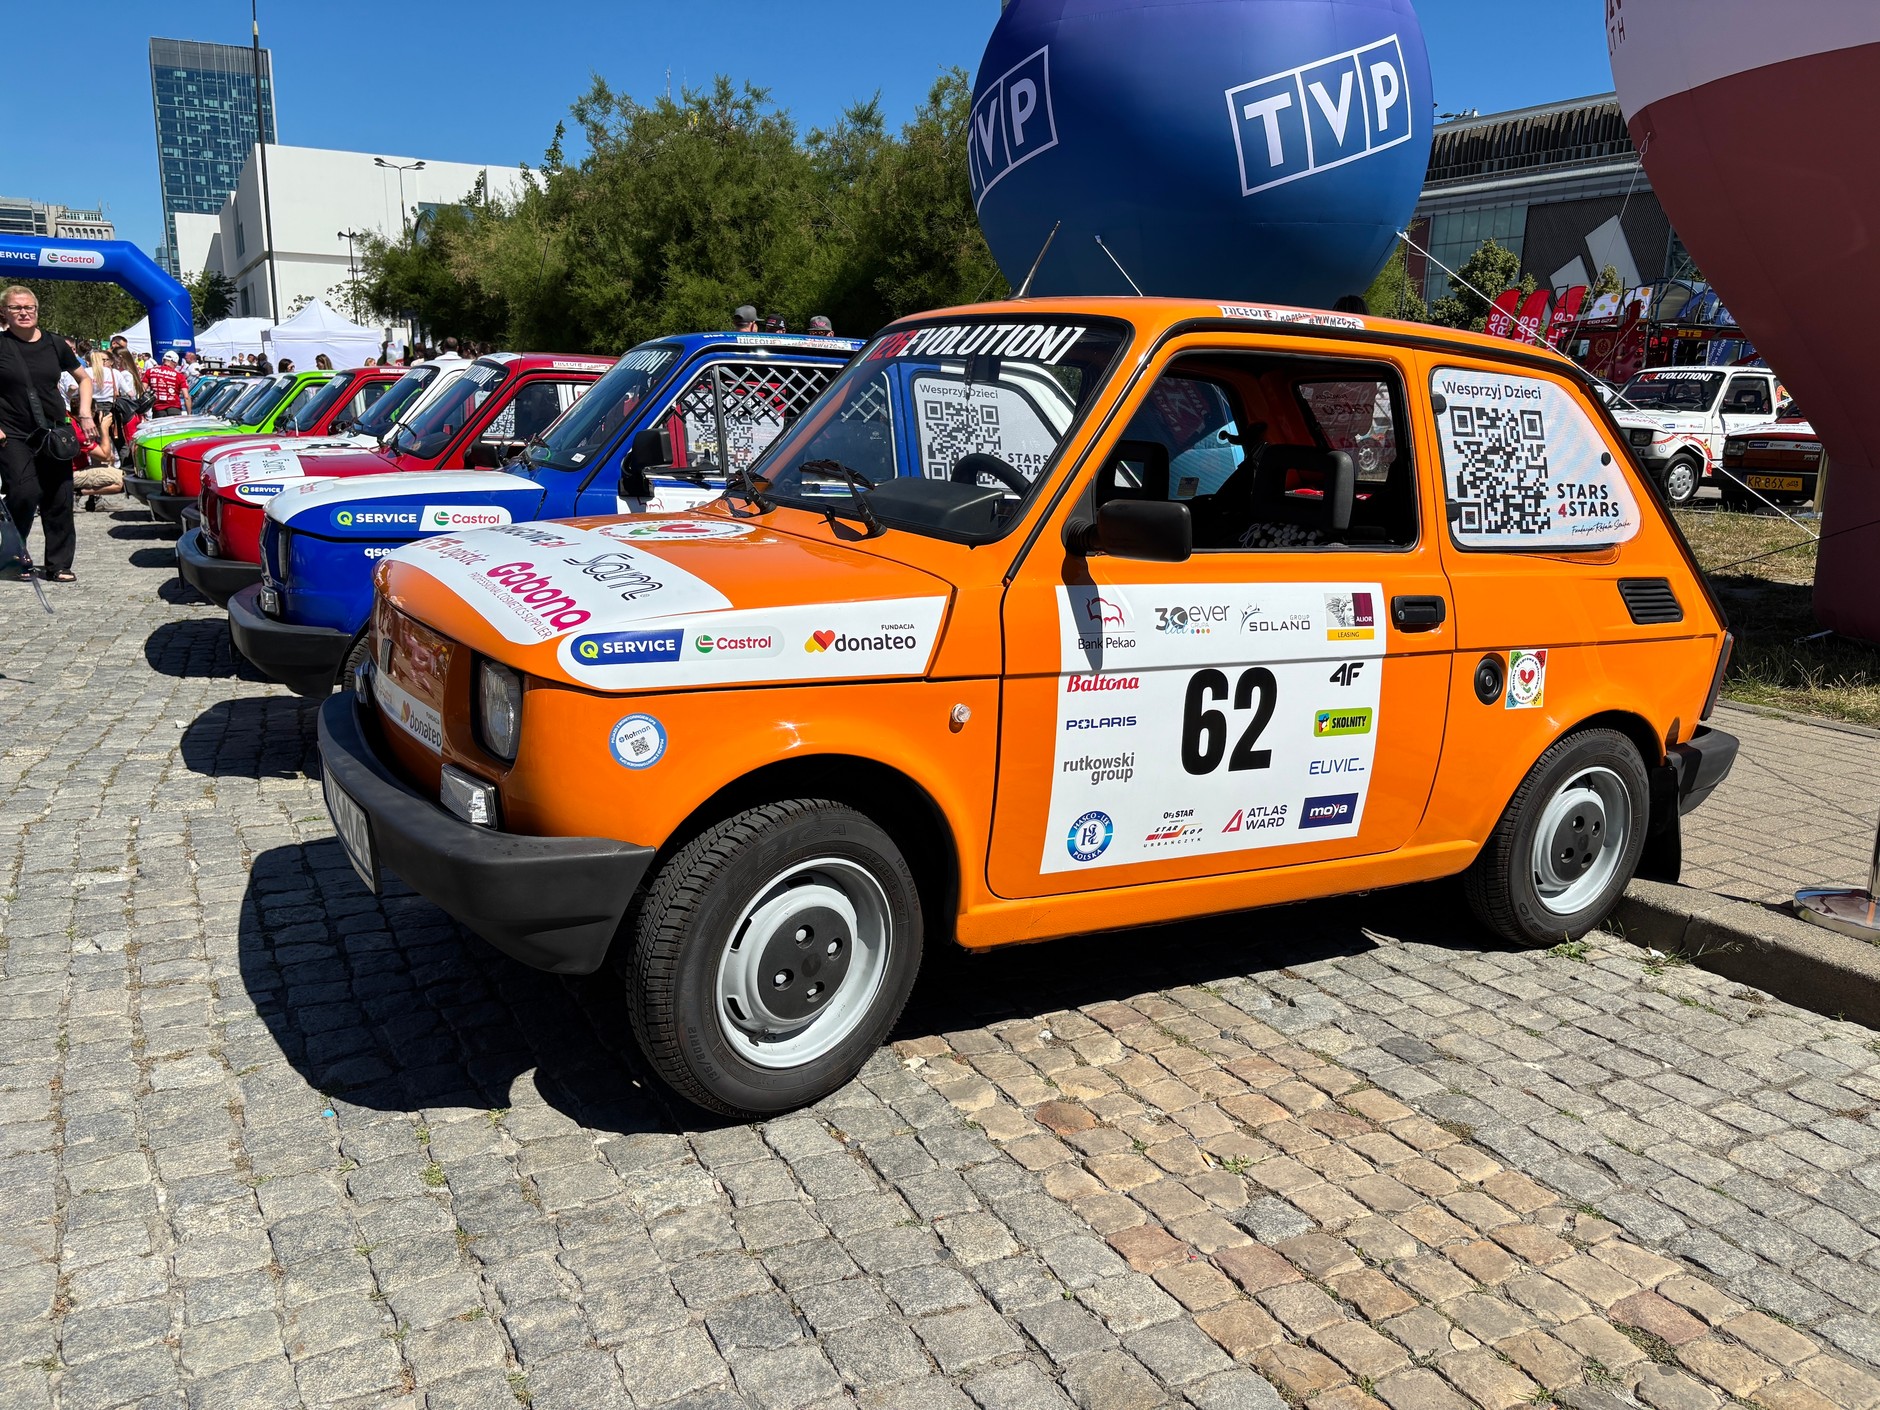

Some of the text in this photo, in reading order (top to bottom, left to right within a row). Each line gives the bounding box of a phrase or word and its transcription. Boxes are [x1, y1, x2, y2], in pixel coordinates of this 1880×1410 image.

[1244, 60, 1398, 167] TVP
[0, 251, 95, 264] ERVICE Castrol
[1514, 315, 1529, 343] LAS
[1525, 317, 1540, 345] ARD
[1678, 330, 1702, 338] STS
[150, 369, 177, 377] POLAND
[919, 384, 967, 398] Wesprzyj
[1442, 381, 1542, 400] Wesprzyj Dzieci
[1008, 453, 1049, 465] STARS
[1747, 476, 1761, 489] KR
[1764, 477, 1785, 489] 86X
[1557, 483, 1608, 500] STARS
[1558, 501, 1619, 518] 4STARS
[356, 513, 417, 523] SERVICE
[452, 513, 500, 524] Castrol
[486, 562, 592, 632] Gabona
[499, 588, 527, 621] COSMETICS
[523, 611, 553, 640] SUPPLIER
[1188, 605, 1230, 622] ever
[880, 623, 915, 631] FUNDACJA
[1249, 621, 1310, 632] SOLANO
[603, 638, 676, 655] SERVICE
[716, 635, 772, 651] Castrol
[834, 633, 917, 653] donateo
[1078, 637, 1136, 650] Bank Pekao
[1329, 662, 1364, 687] 4F
[1067, 674, 1139, 693] Baltona
[410, 710, 442, 748] donateo
[1066, 716, 1137, 730] POLARIS
[1181, 667, 1278, 775] 62
[1331, 715, 1367, 729] SKOLNITY
[624, 725, 651, 741] flotman
[1063, 752, 1135, 772] rutkowski
[1091, 768, 1134, 785] group
[1247, 804, 1287, 818] ATLAS
[1309, 803, 1348, 819] moya
[1155, 825, 1179, 833] STAR
[1245, 816, 1285, 831] WARD
[1182, 828, 1203, 836] KOP
[1073, 849, 1102, 861] POLSKA
[684, 1026, 720, 1083] 135/80R12
